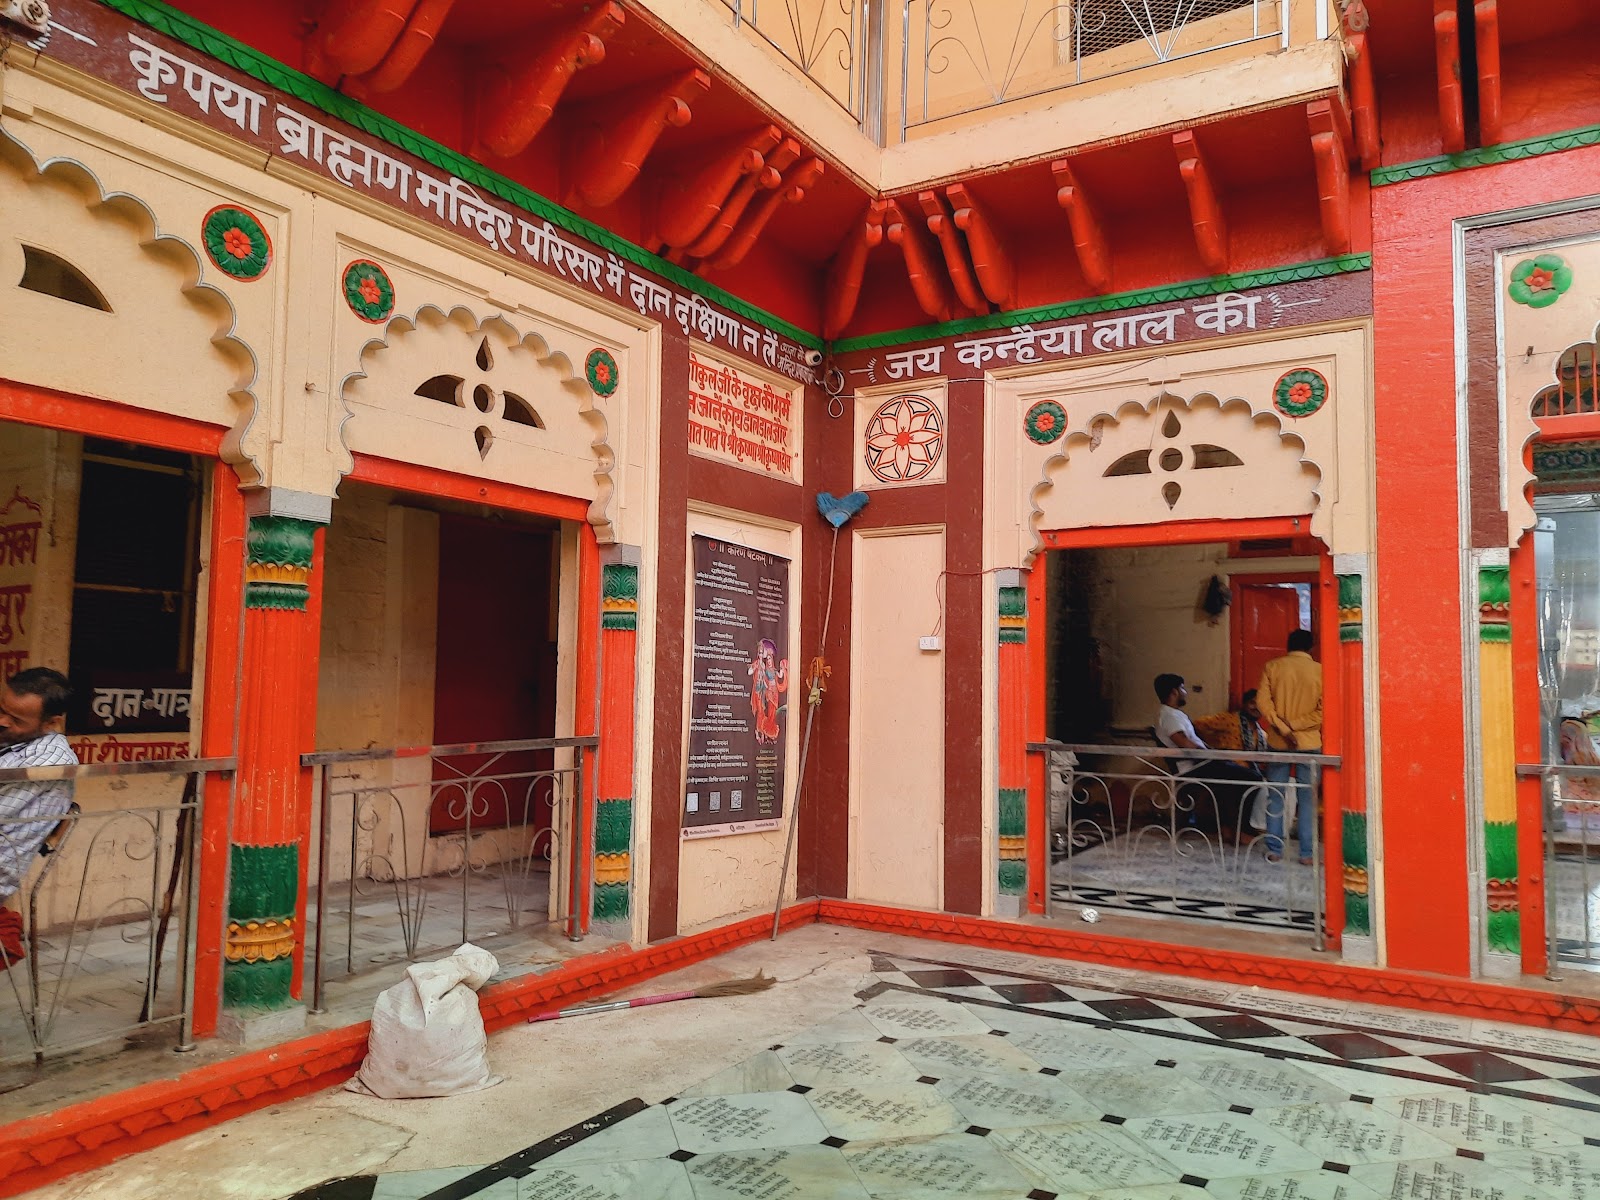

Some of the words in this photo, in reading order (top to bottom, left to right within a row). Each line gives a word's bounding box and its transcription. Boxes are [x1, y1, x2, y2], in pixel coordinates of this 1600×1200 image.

[128, 33, 267, 135] कृपया
[276, 103, 413, 203] ब्राह्मण
[416, 177, 516, 254] मन्दिर
[517, 222, 604, 292] परिसर
[605, 253, 626, 297] में
[629, 272, 672, 319] दान
[674, 291, 740, 349] दक्षिणा
[742, 325, 760, 356] न
[762, 329, 778, 367] लें
[884, 346, 945, 379] जय
[954, 325, 1087, 369] कन्हैया
[1092, 308, 1185, 351] लाल
[1193, 293, 1262, 334] की
